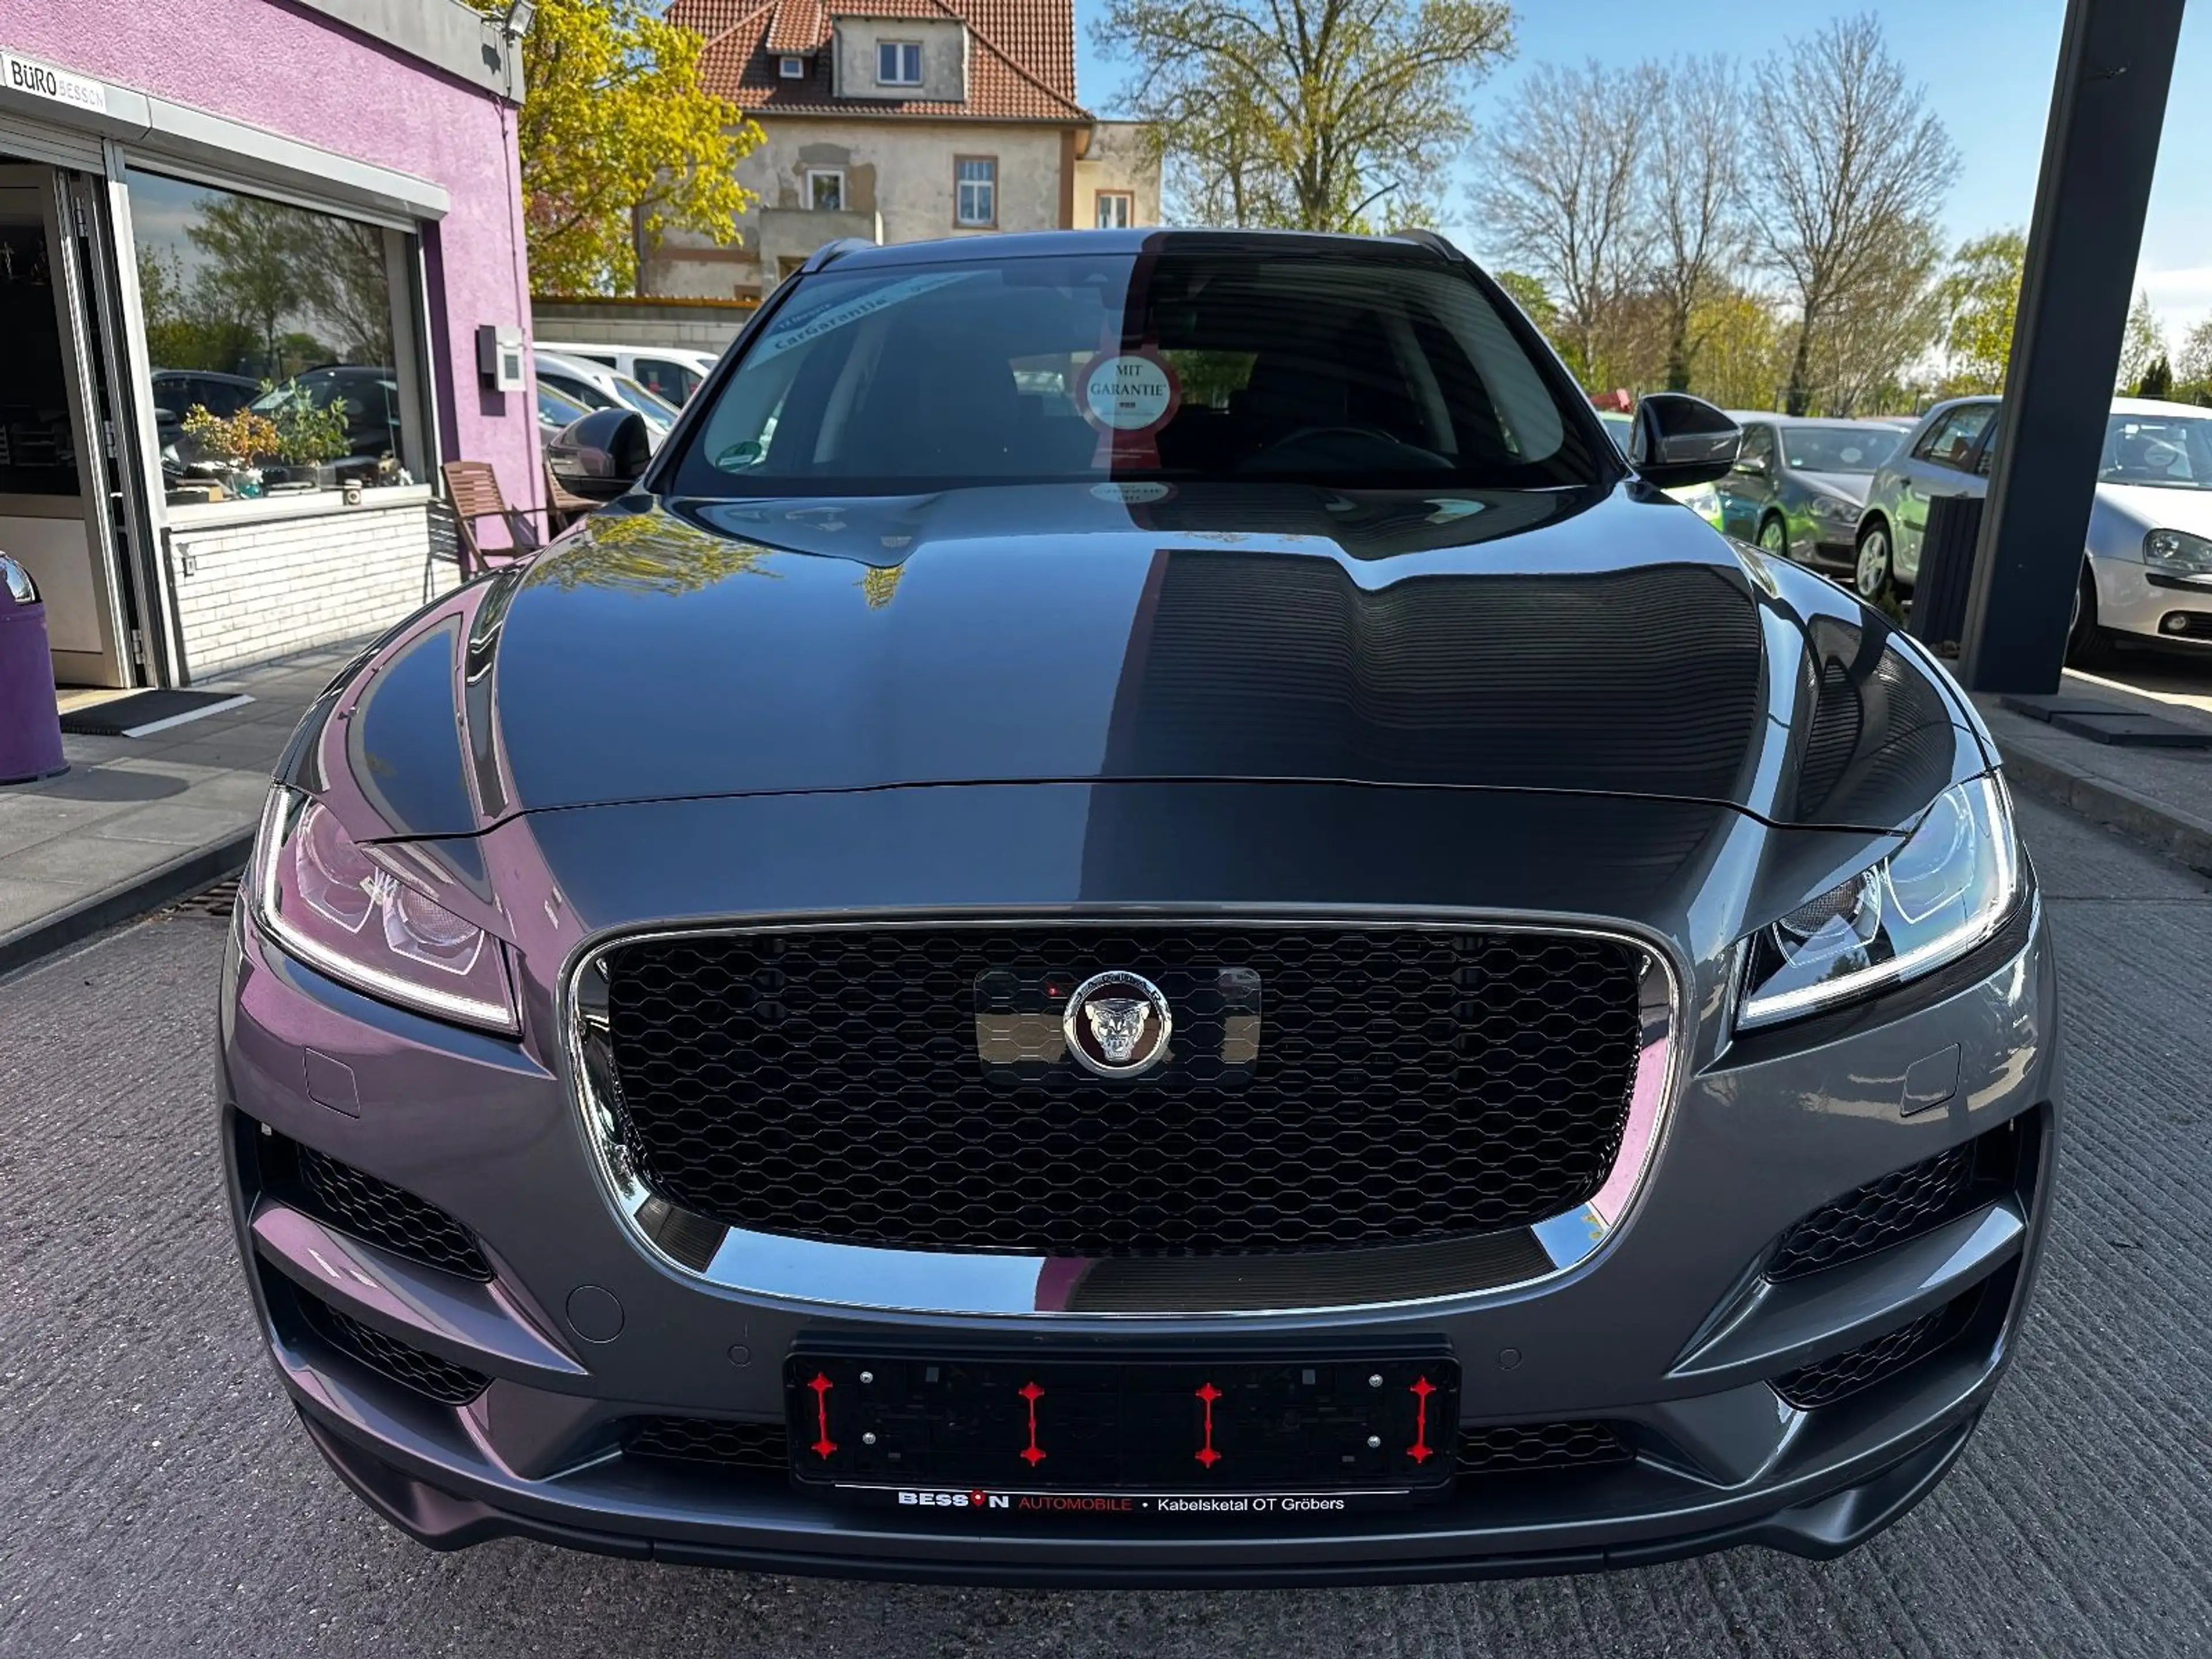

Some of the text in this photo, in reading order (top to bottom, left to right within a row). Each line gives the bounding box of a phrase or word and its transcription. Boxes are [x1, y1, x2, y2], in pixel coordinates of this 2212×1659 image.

[59, 80, 104, 108] BESSON
[1116, 365, 1143, 376] MIT
[1018, 1497, 1133, 1511] AUTOMOBILE
[1158, 1498, 1248, 1511] Kabelsketal
[1252, 1498, 1277, 1511] OT
[1282, 1498, 1345, 1510] Gröbers
